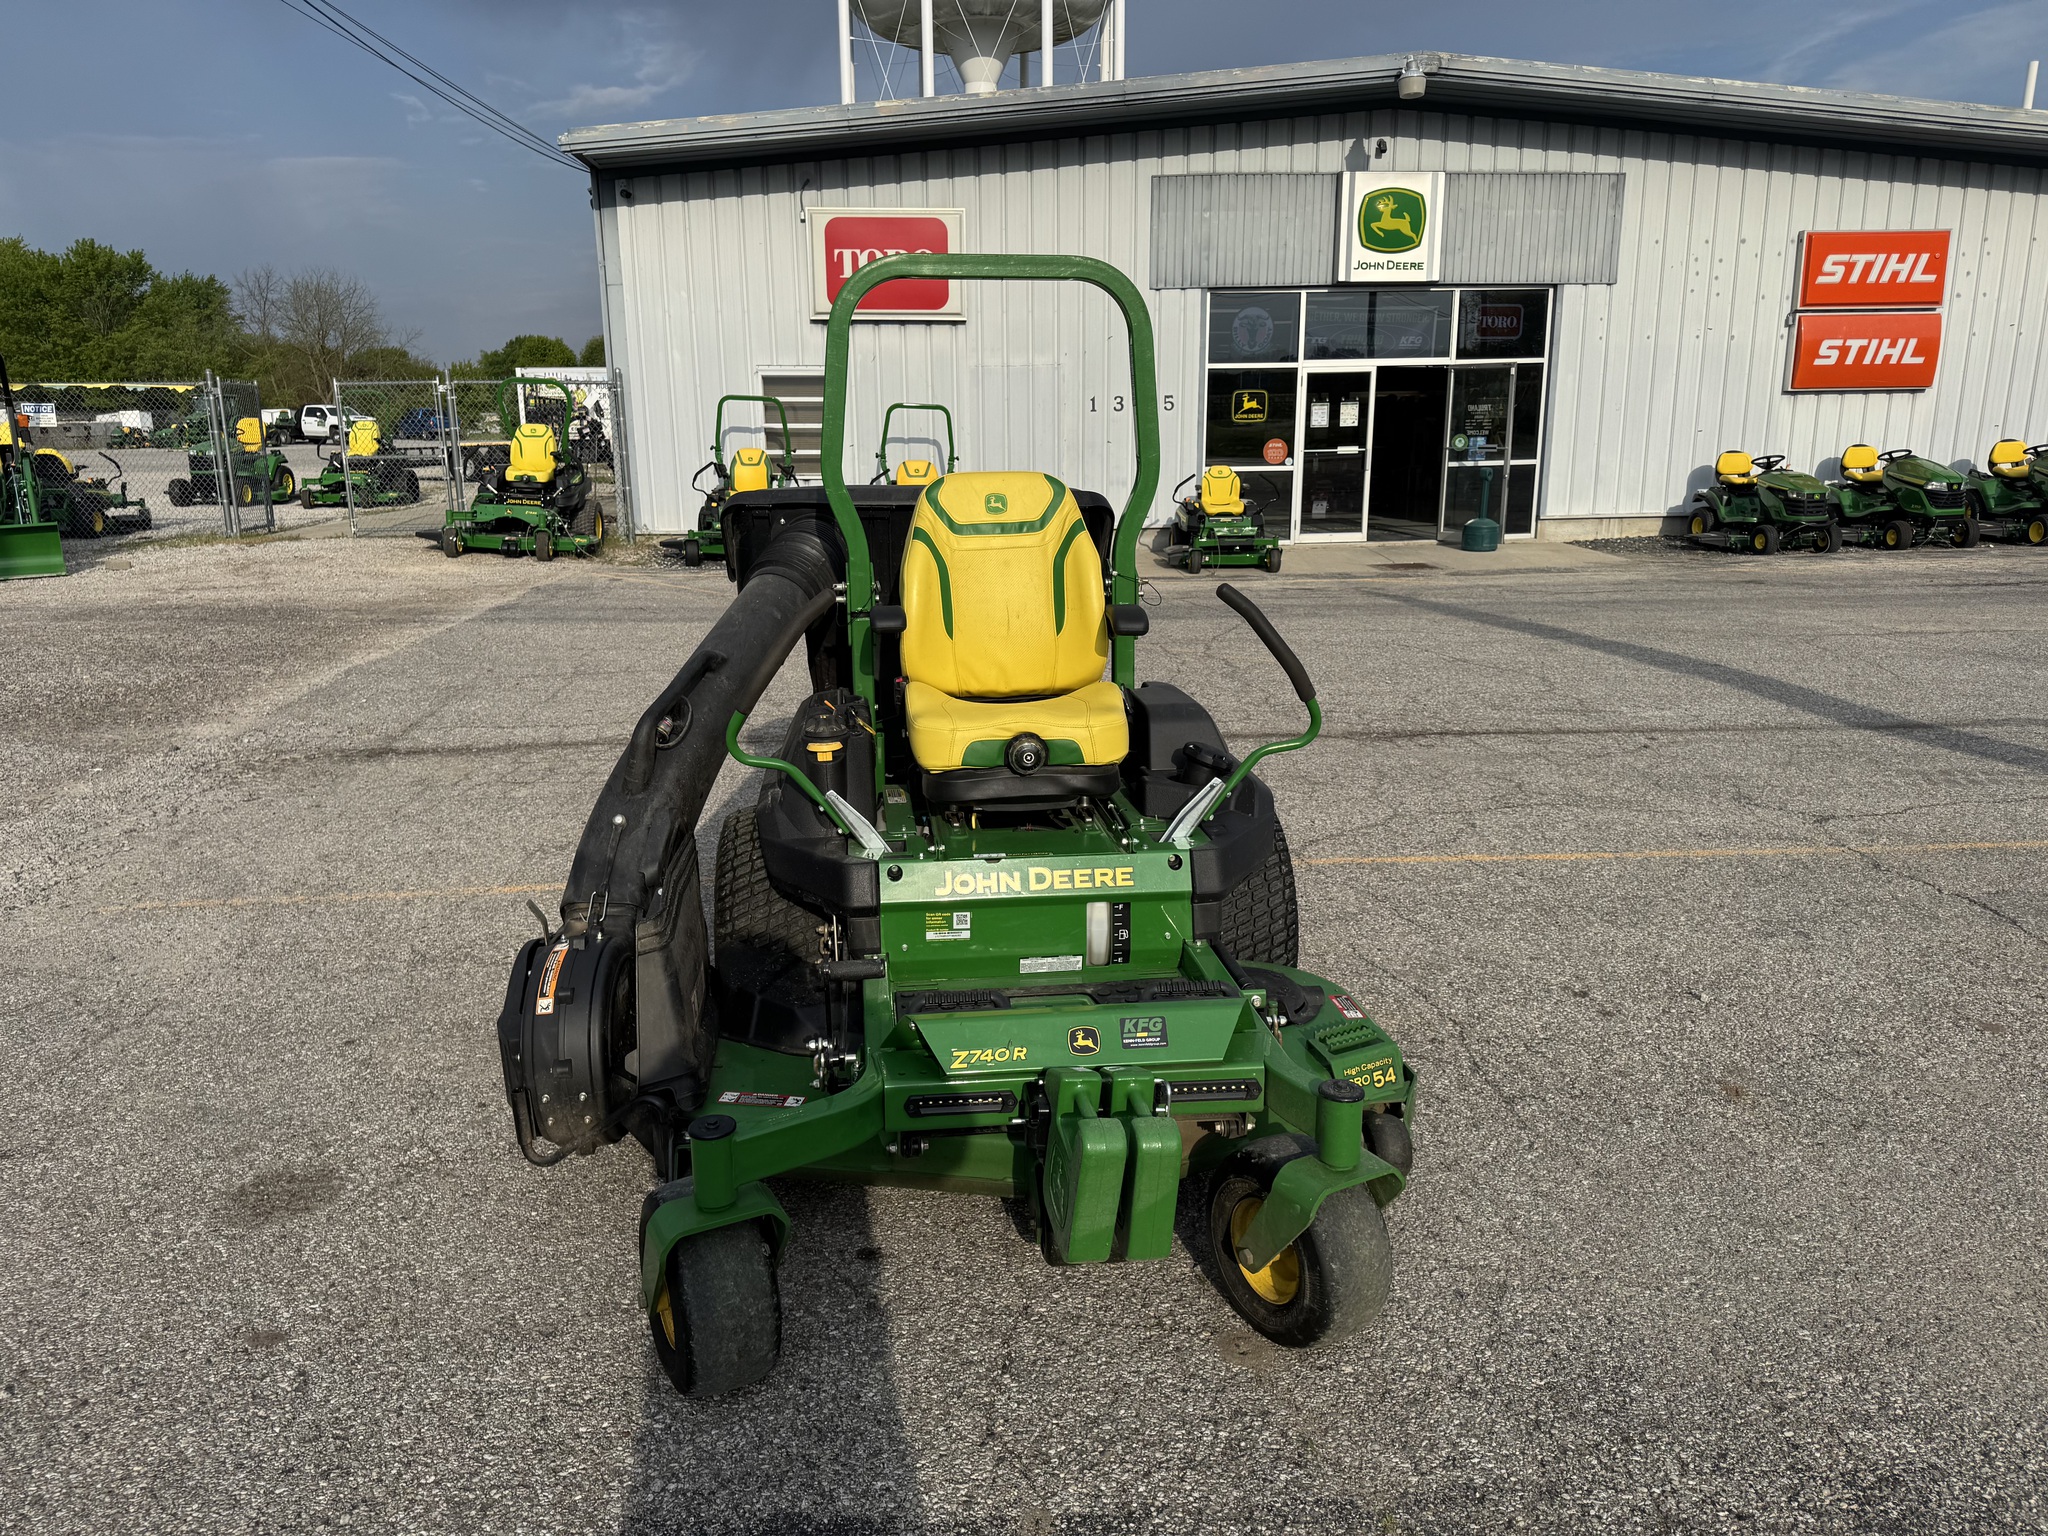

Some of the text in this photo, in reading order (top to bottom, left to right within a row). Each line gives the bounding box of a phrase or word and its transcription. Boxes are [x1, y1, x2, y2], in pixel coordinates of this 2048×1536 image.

[834, 249, 933, 279] TO
[1353, 260, 1424, 271] JOHN DEERE
[1815, 253, 1938, 284] STIHL
[1480, 315, 1517, 328] TORO
[1400, 336, 1423, 344] KFG
[1813, 338, 1926, 366] STIHL
[24, 405, 53, 413] NOTICE
[934, 866, 1135, 897] JOHN DEERE
[1124, 1017, 1163, 1032] KFG
[1343, 1057, 1393, 1076] High Capacity
[1372, 1066, 1396, 1088] 54
